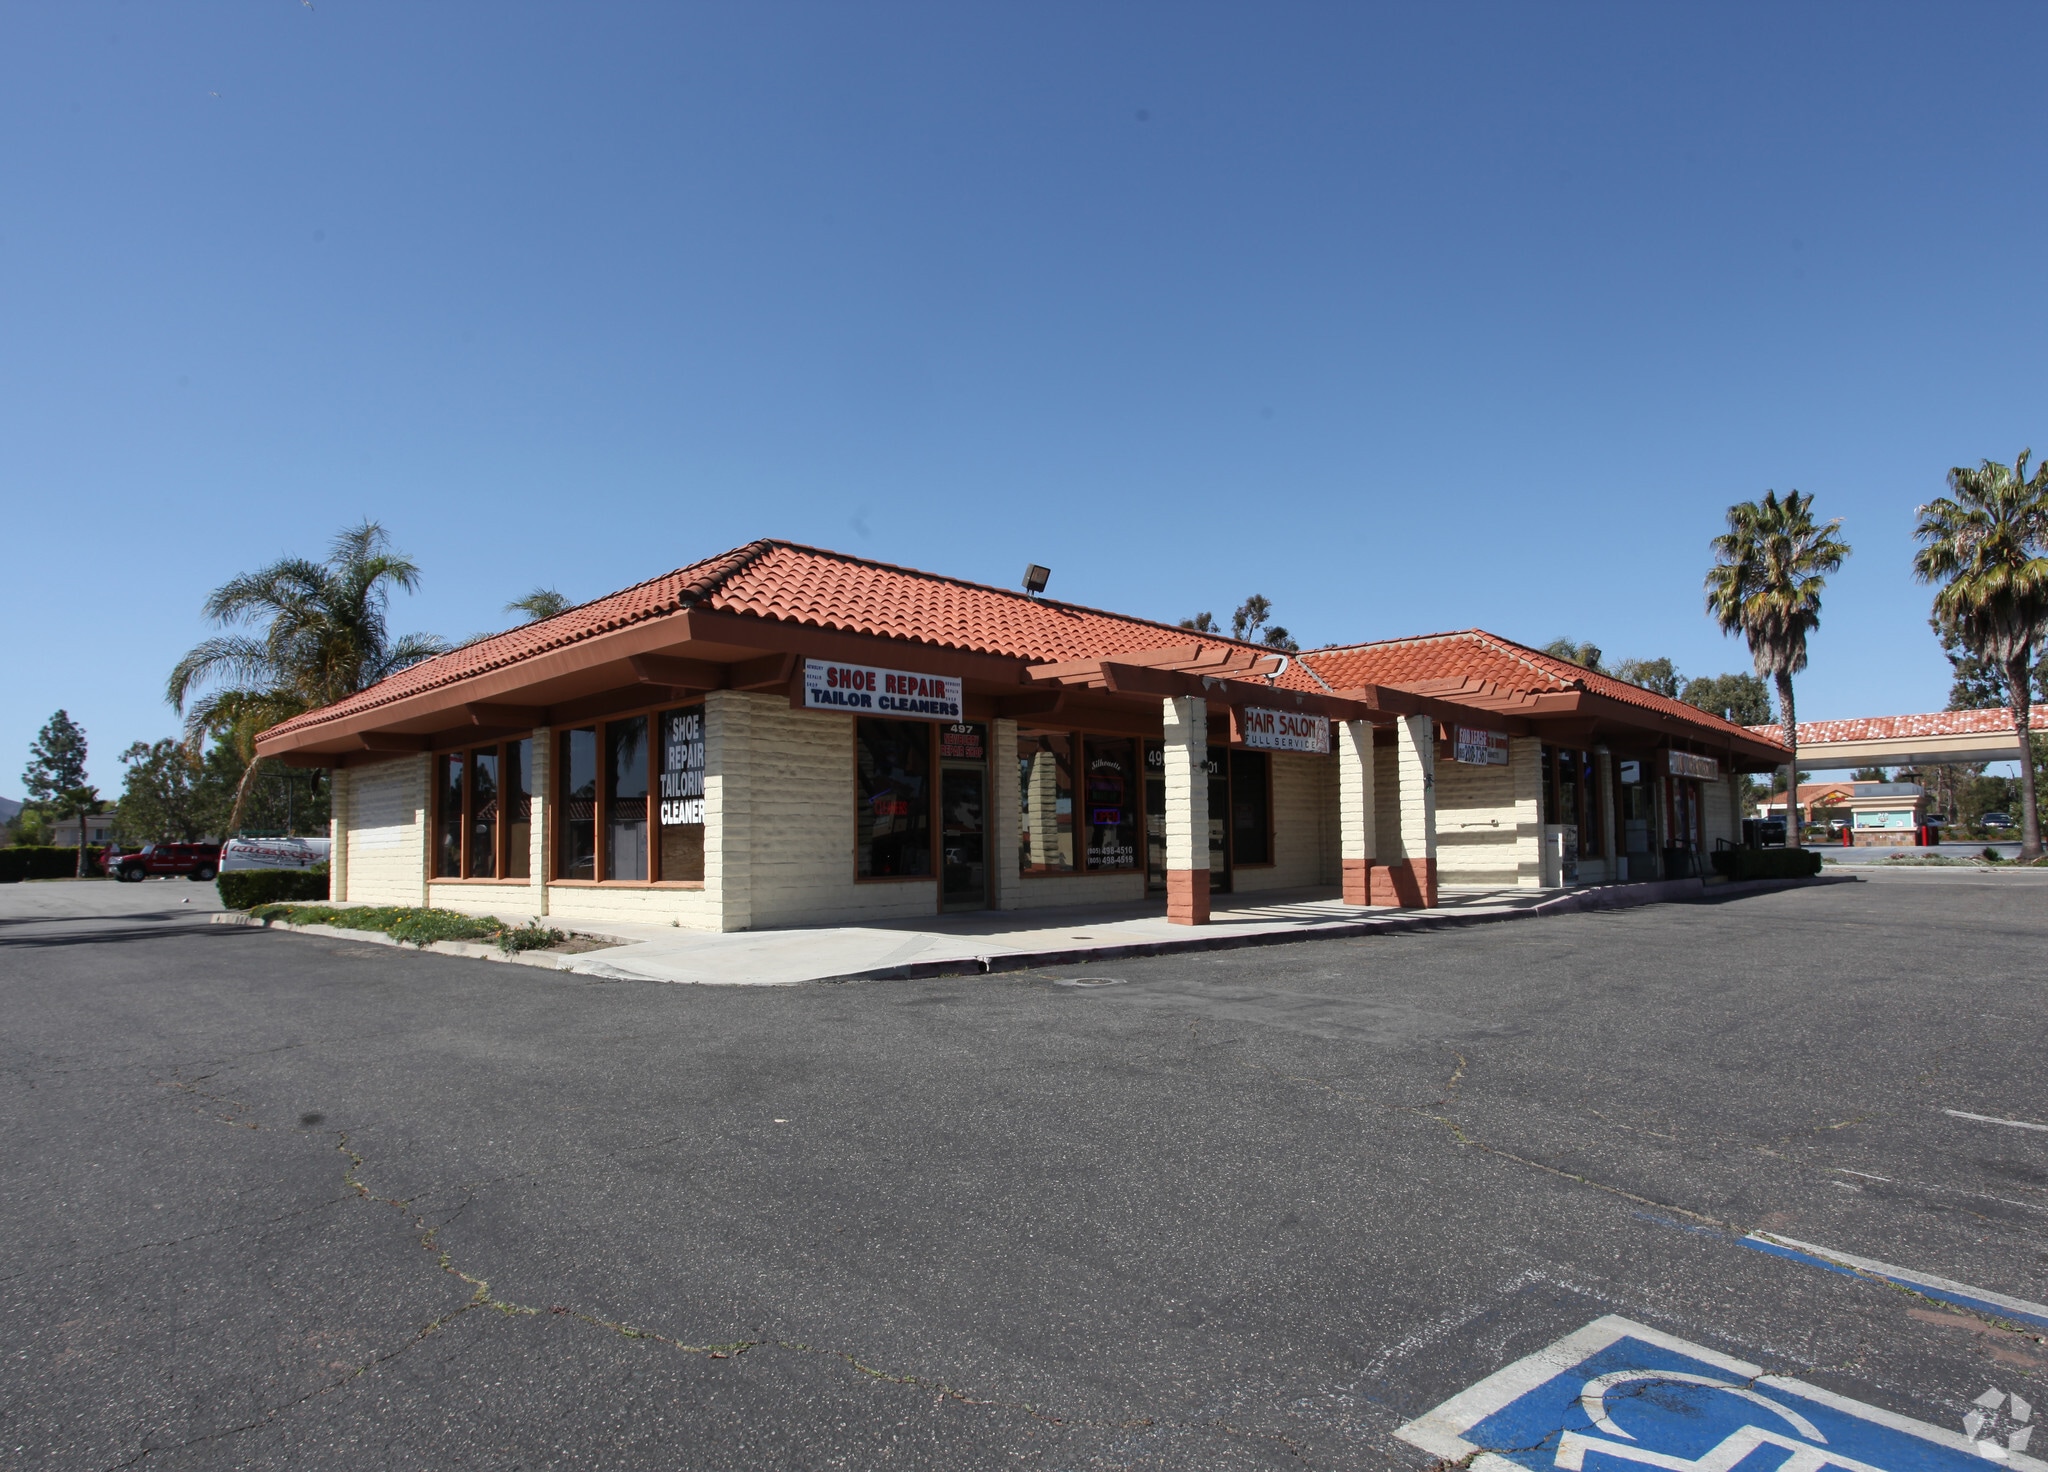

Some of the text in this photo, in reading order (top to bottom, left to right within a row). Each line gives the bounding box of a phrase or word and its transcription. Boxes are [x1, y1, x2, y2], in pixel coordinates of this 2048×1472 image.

[827, 667, 946, 699] SHOE REPAIR
[811, 689, 960, 717] TAILOR CLEANERS
[672, 714, 700, 743] SHOE
[950, 724, 973, 734] 497
[1245, 710, 1316, 738] HAIR SALON
[1245, 734, 1316, 749] FULL SERVICE
[668, 742, 705, 771] REPAIR
[1148, 750, 1165, 766] 49
[660, 770, 705, 798] TAILORIN
[661, 799, 705, 826] CLEANER
[1101, 846, 1133, 856] 498-4510
